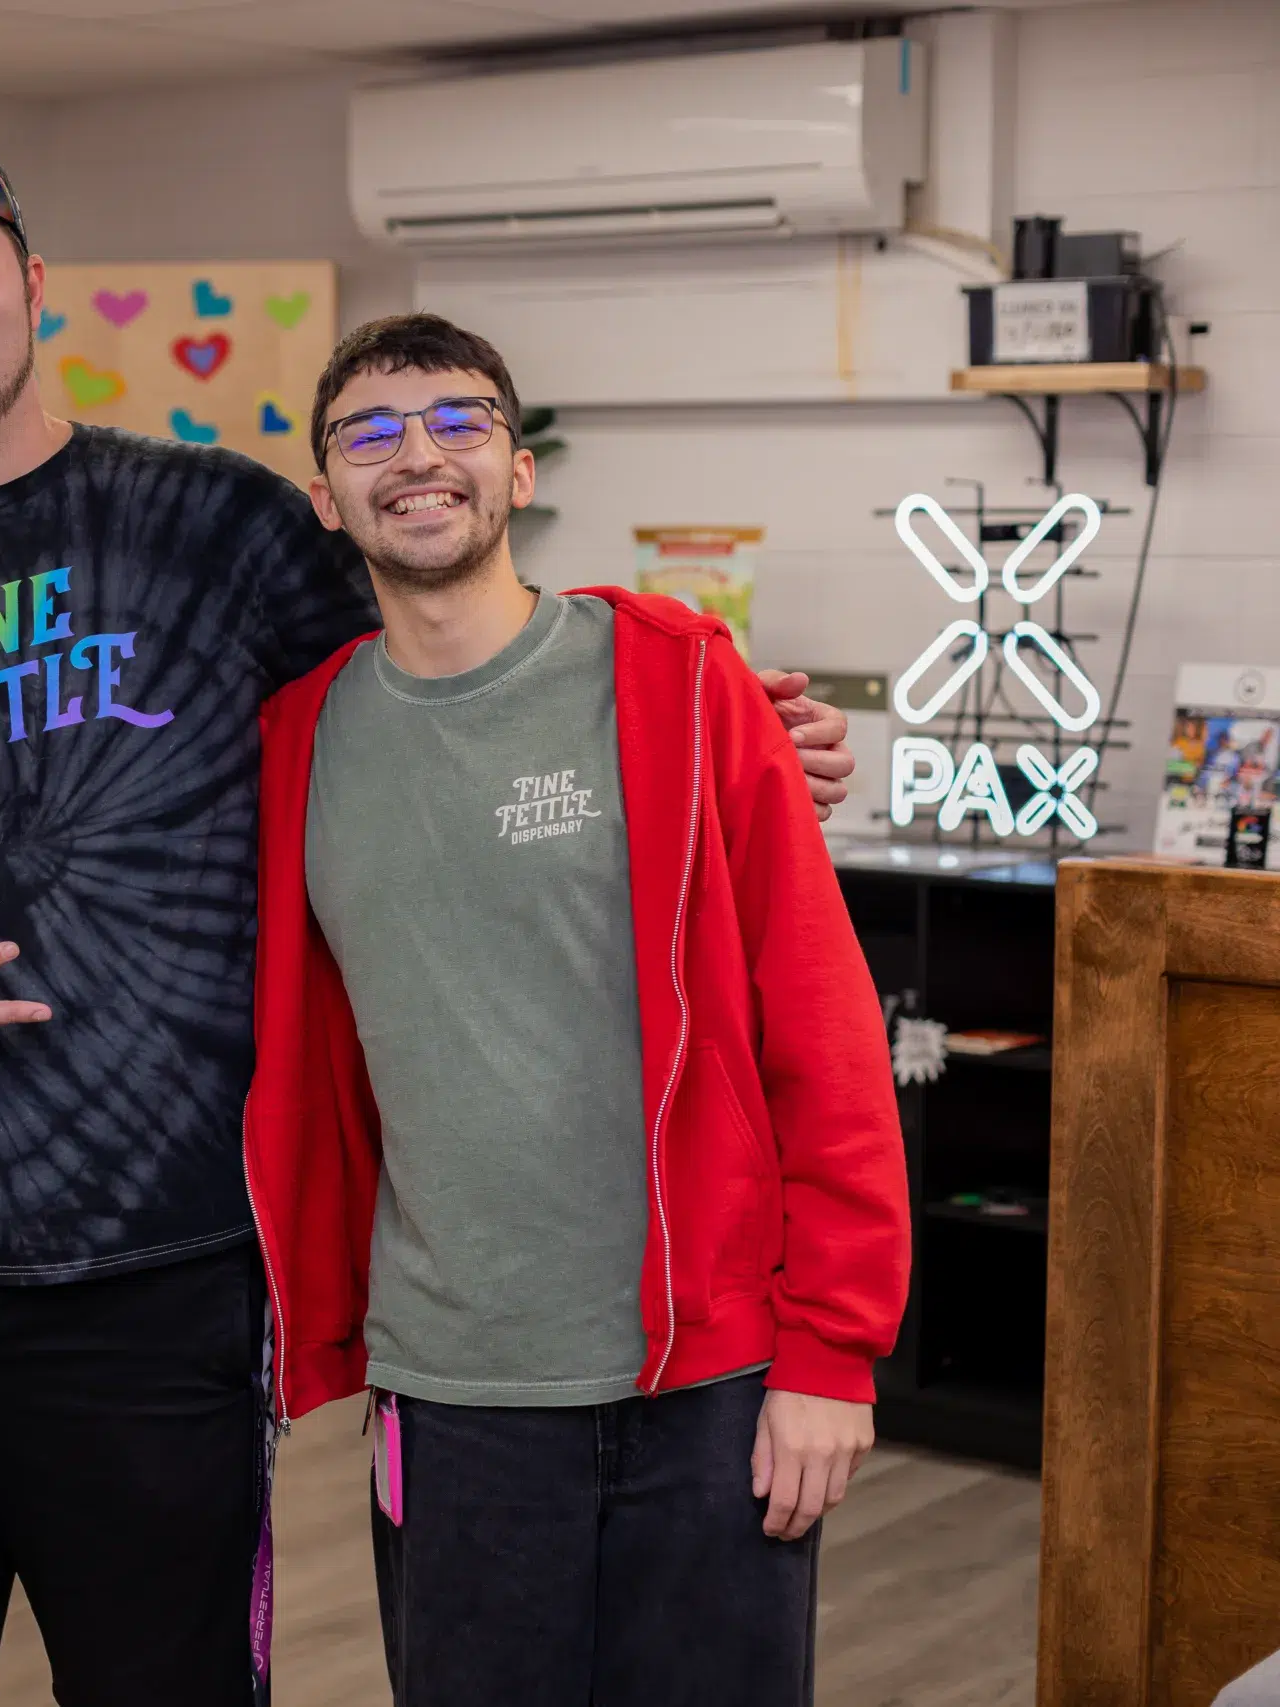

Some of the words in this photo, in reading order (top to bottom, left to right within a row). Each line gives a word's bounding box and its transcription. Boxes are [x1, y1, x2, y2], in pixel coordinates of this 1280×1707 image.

[512, 769, 576, 802] FINE
[890, 736, 1099, 839] PAX
[495, 789, 602, 837] FETTLE
[511, 819, 583, 845] DISPENSARY
[253, 1560, 272, 1651] PERPETUAL
